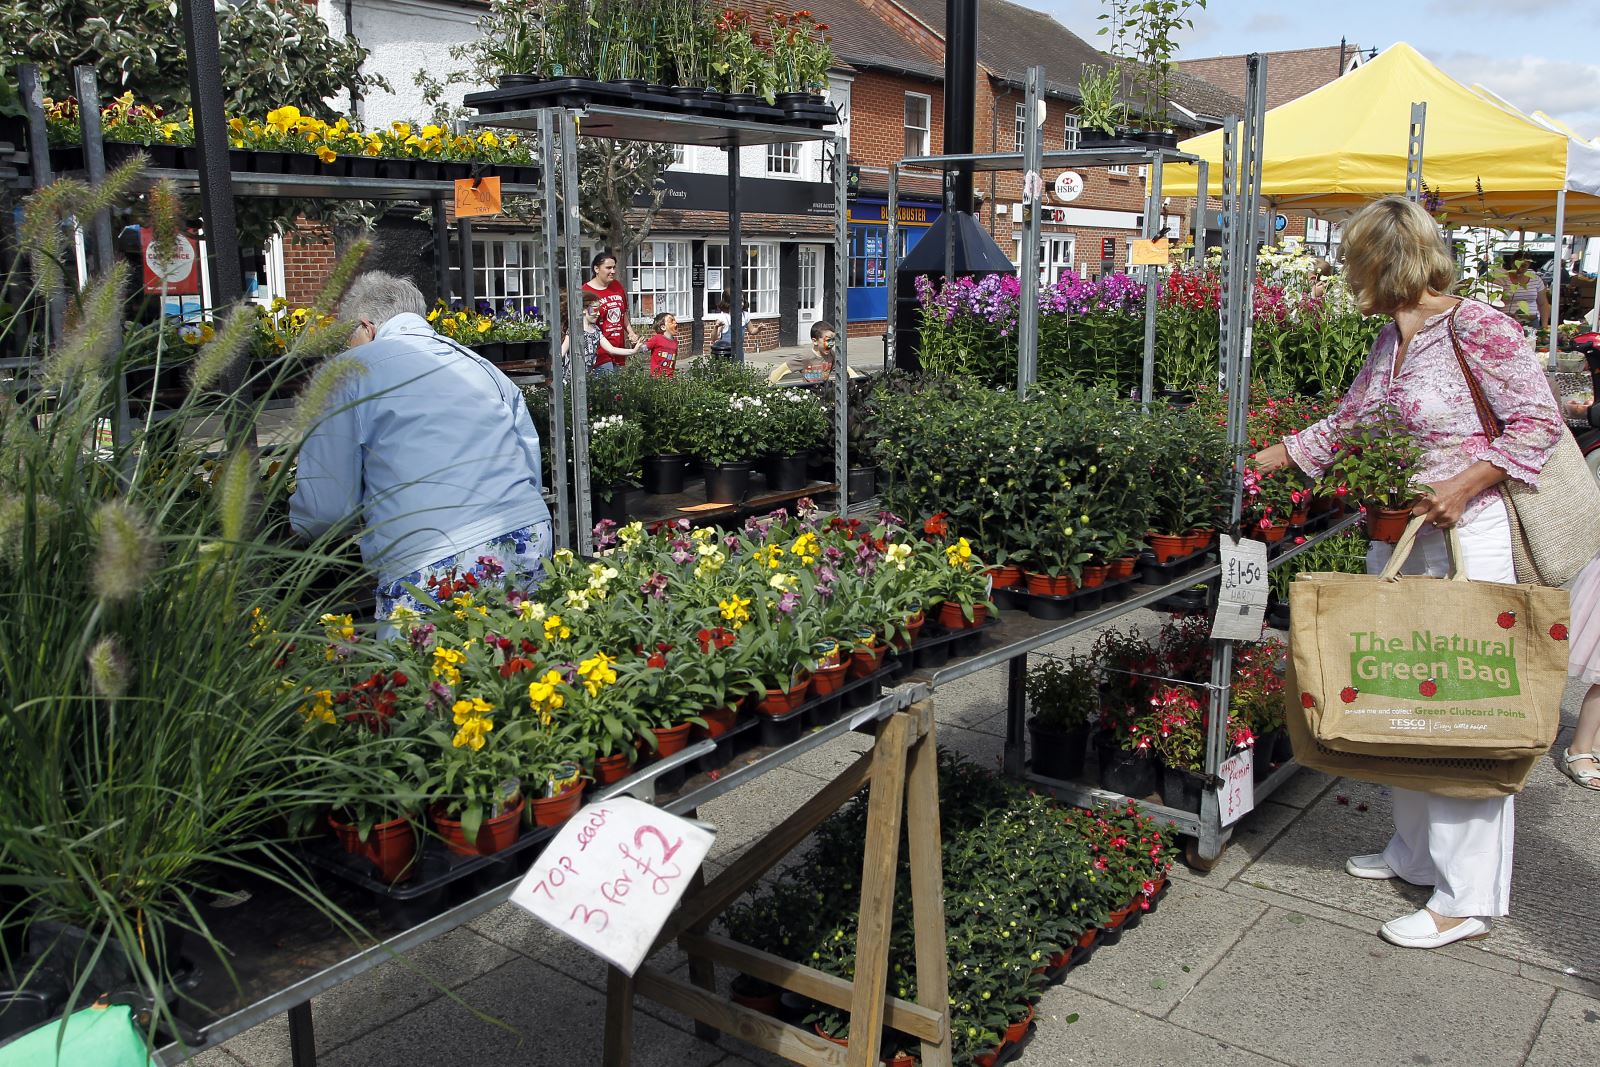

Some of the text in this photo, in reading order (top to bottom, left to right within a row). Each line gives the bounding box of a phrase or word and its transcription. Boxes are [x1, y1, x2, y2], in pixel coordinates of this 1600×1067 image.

[1057, 185, 1079, 193] HSBC
[881, 205, 926, 221] BLKBUSTER
[1350, 630, 1514, 658] The Natural
[1356, 655, 1511, 689] Green Bag
[1389, 718, 1426, 730] TESCO
[1433, 722, 1452, 732] Every
[1415, 707, 1446, 715] Green
[1449, 707, 1494, 716] Clubcard
[1497, 708, 1526, 719] Points
[1228, 784, 1241, 817] £3
[577, 807, 613, 852] each
[570, 824, 683, 933] 3 for £2
